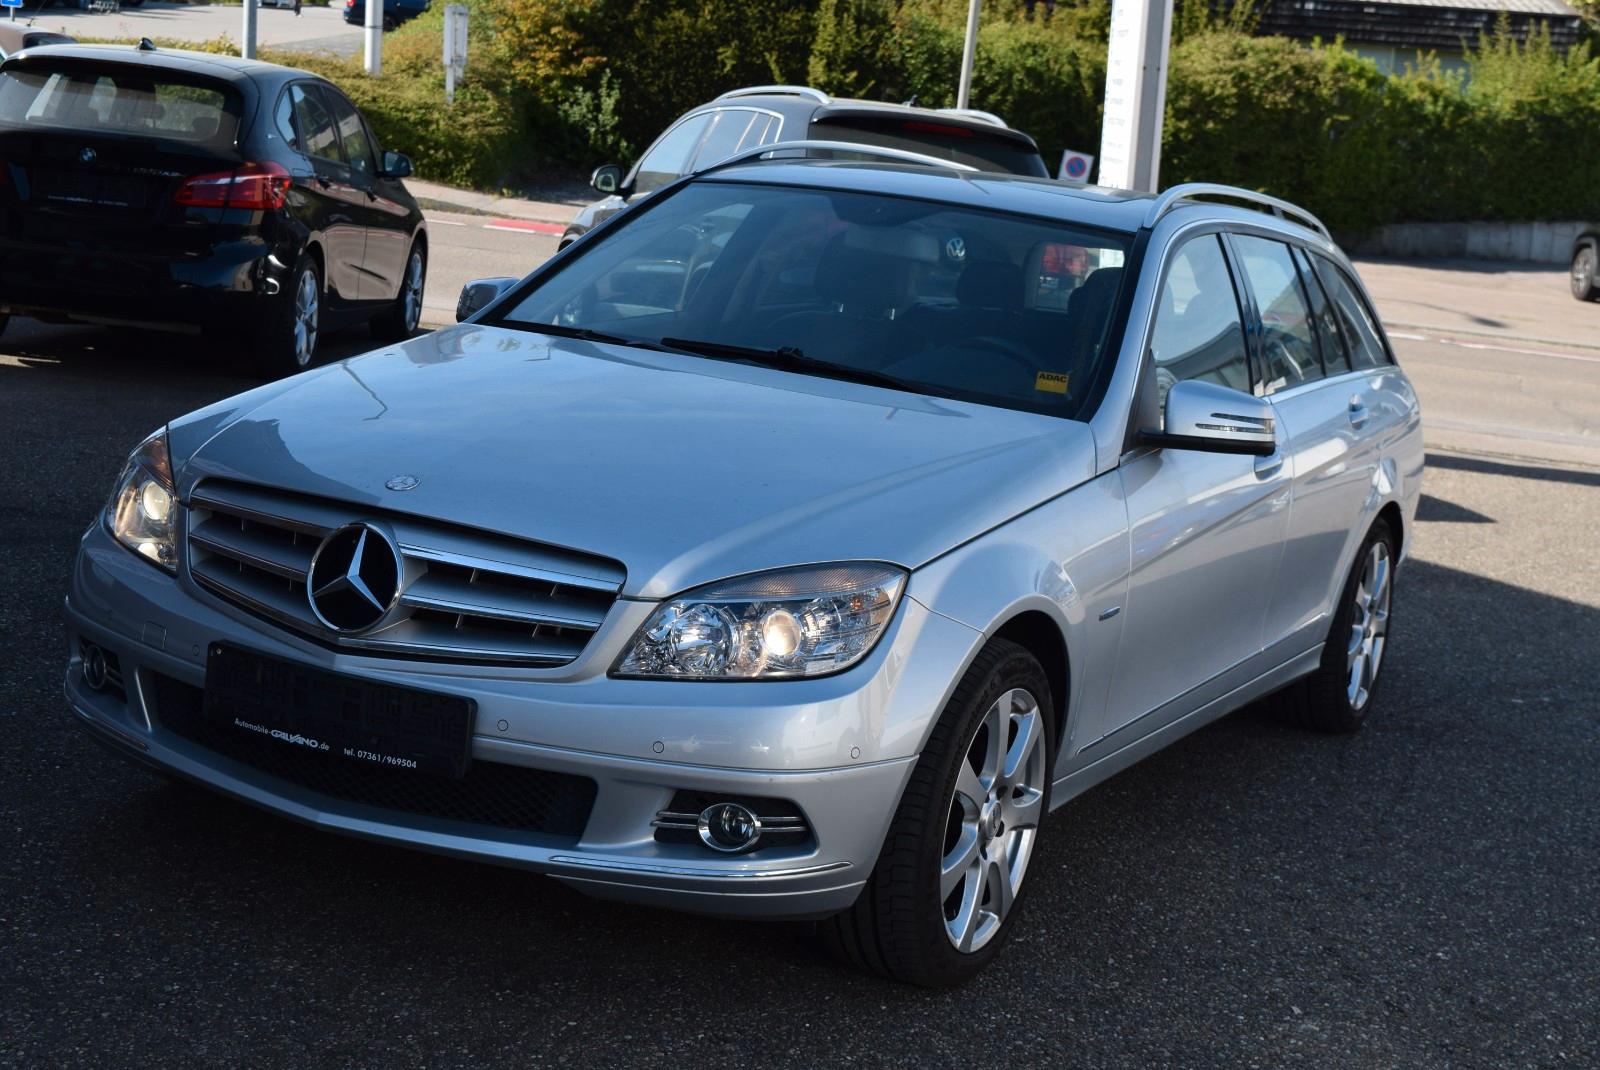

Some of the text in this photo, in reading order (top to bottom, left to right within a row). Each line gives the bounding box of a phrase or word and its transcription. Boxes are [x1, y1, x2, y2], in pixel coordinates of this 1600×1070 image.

[1039, 372, 1067, 384] ADAC
[344, 748, 356, 758] tel.
[357, 750, 417, 770] 07361/969504
